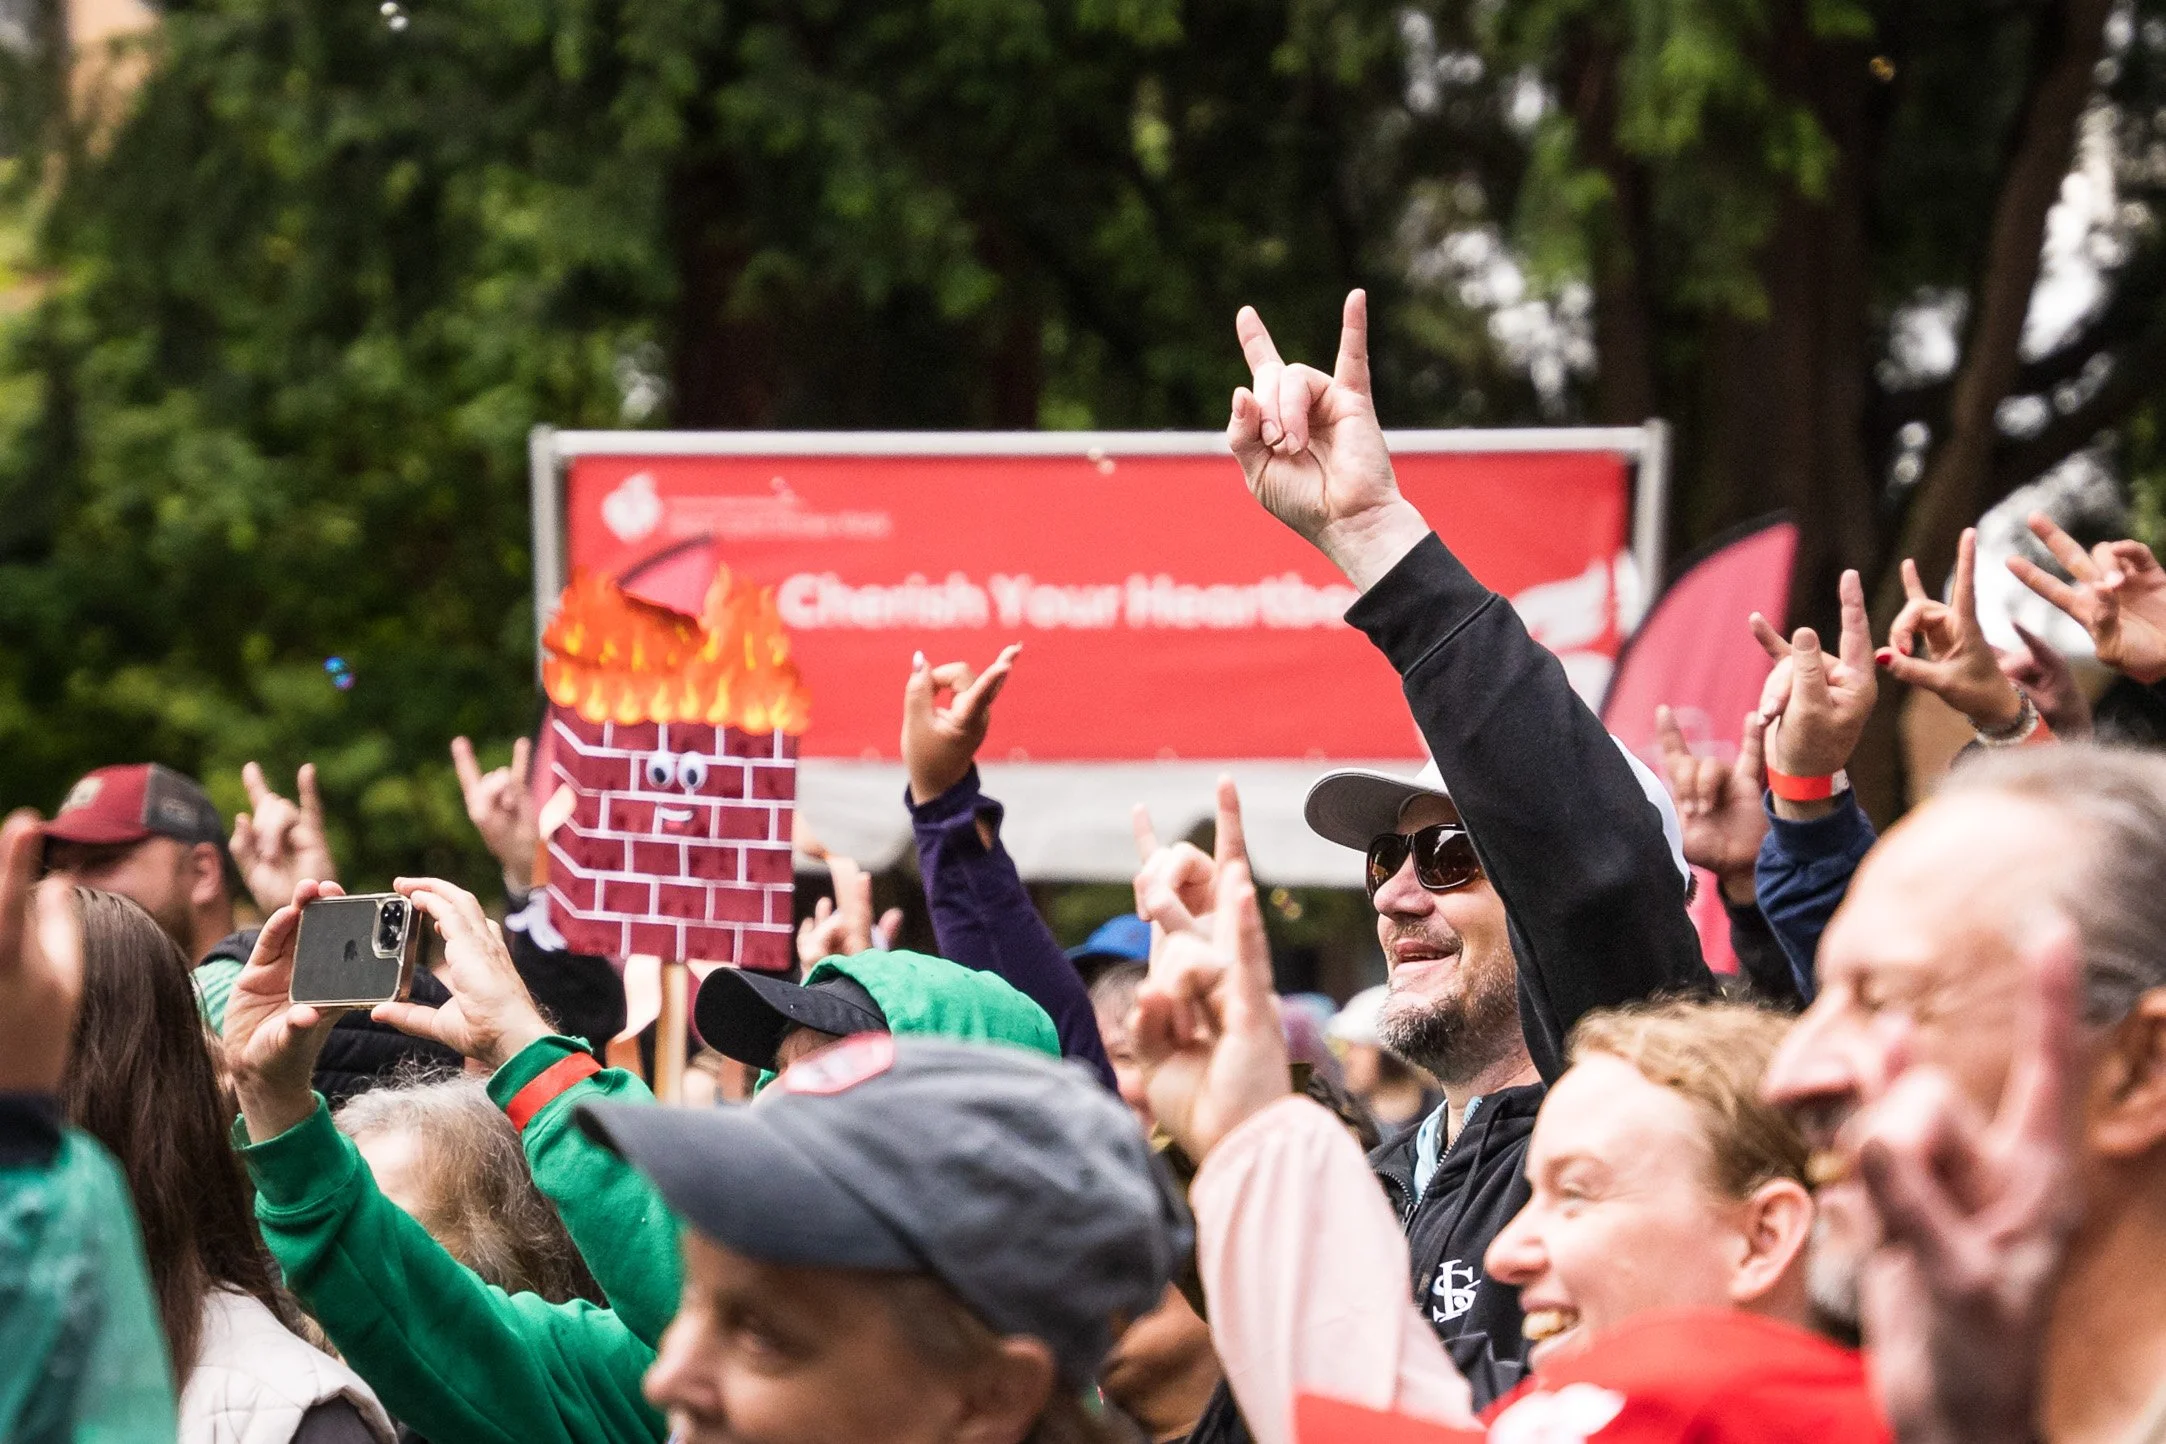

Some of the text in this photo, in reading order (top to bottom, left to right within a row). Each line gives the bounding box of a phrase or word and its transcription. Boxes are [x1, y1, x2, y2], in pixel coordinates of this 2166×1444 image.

[778, 574, 1356, 627] Cherish Your Heartbe
